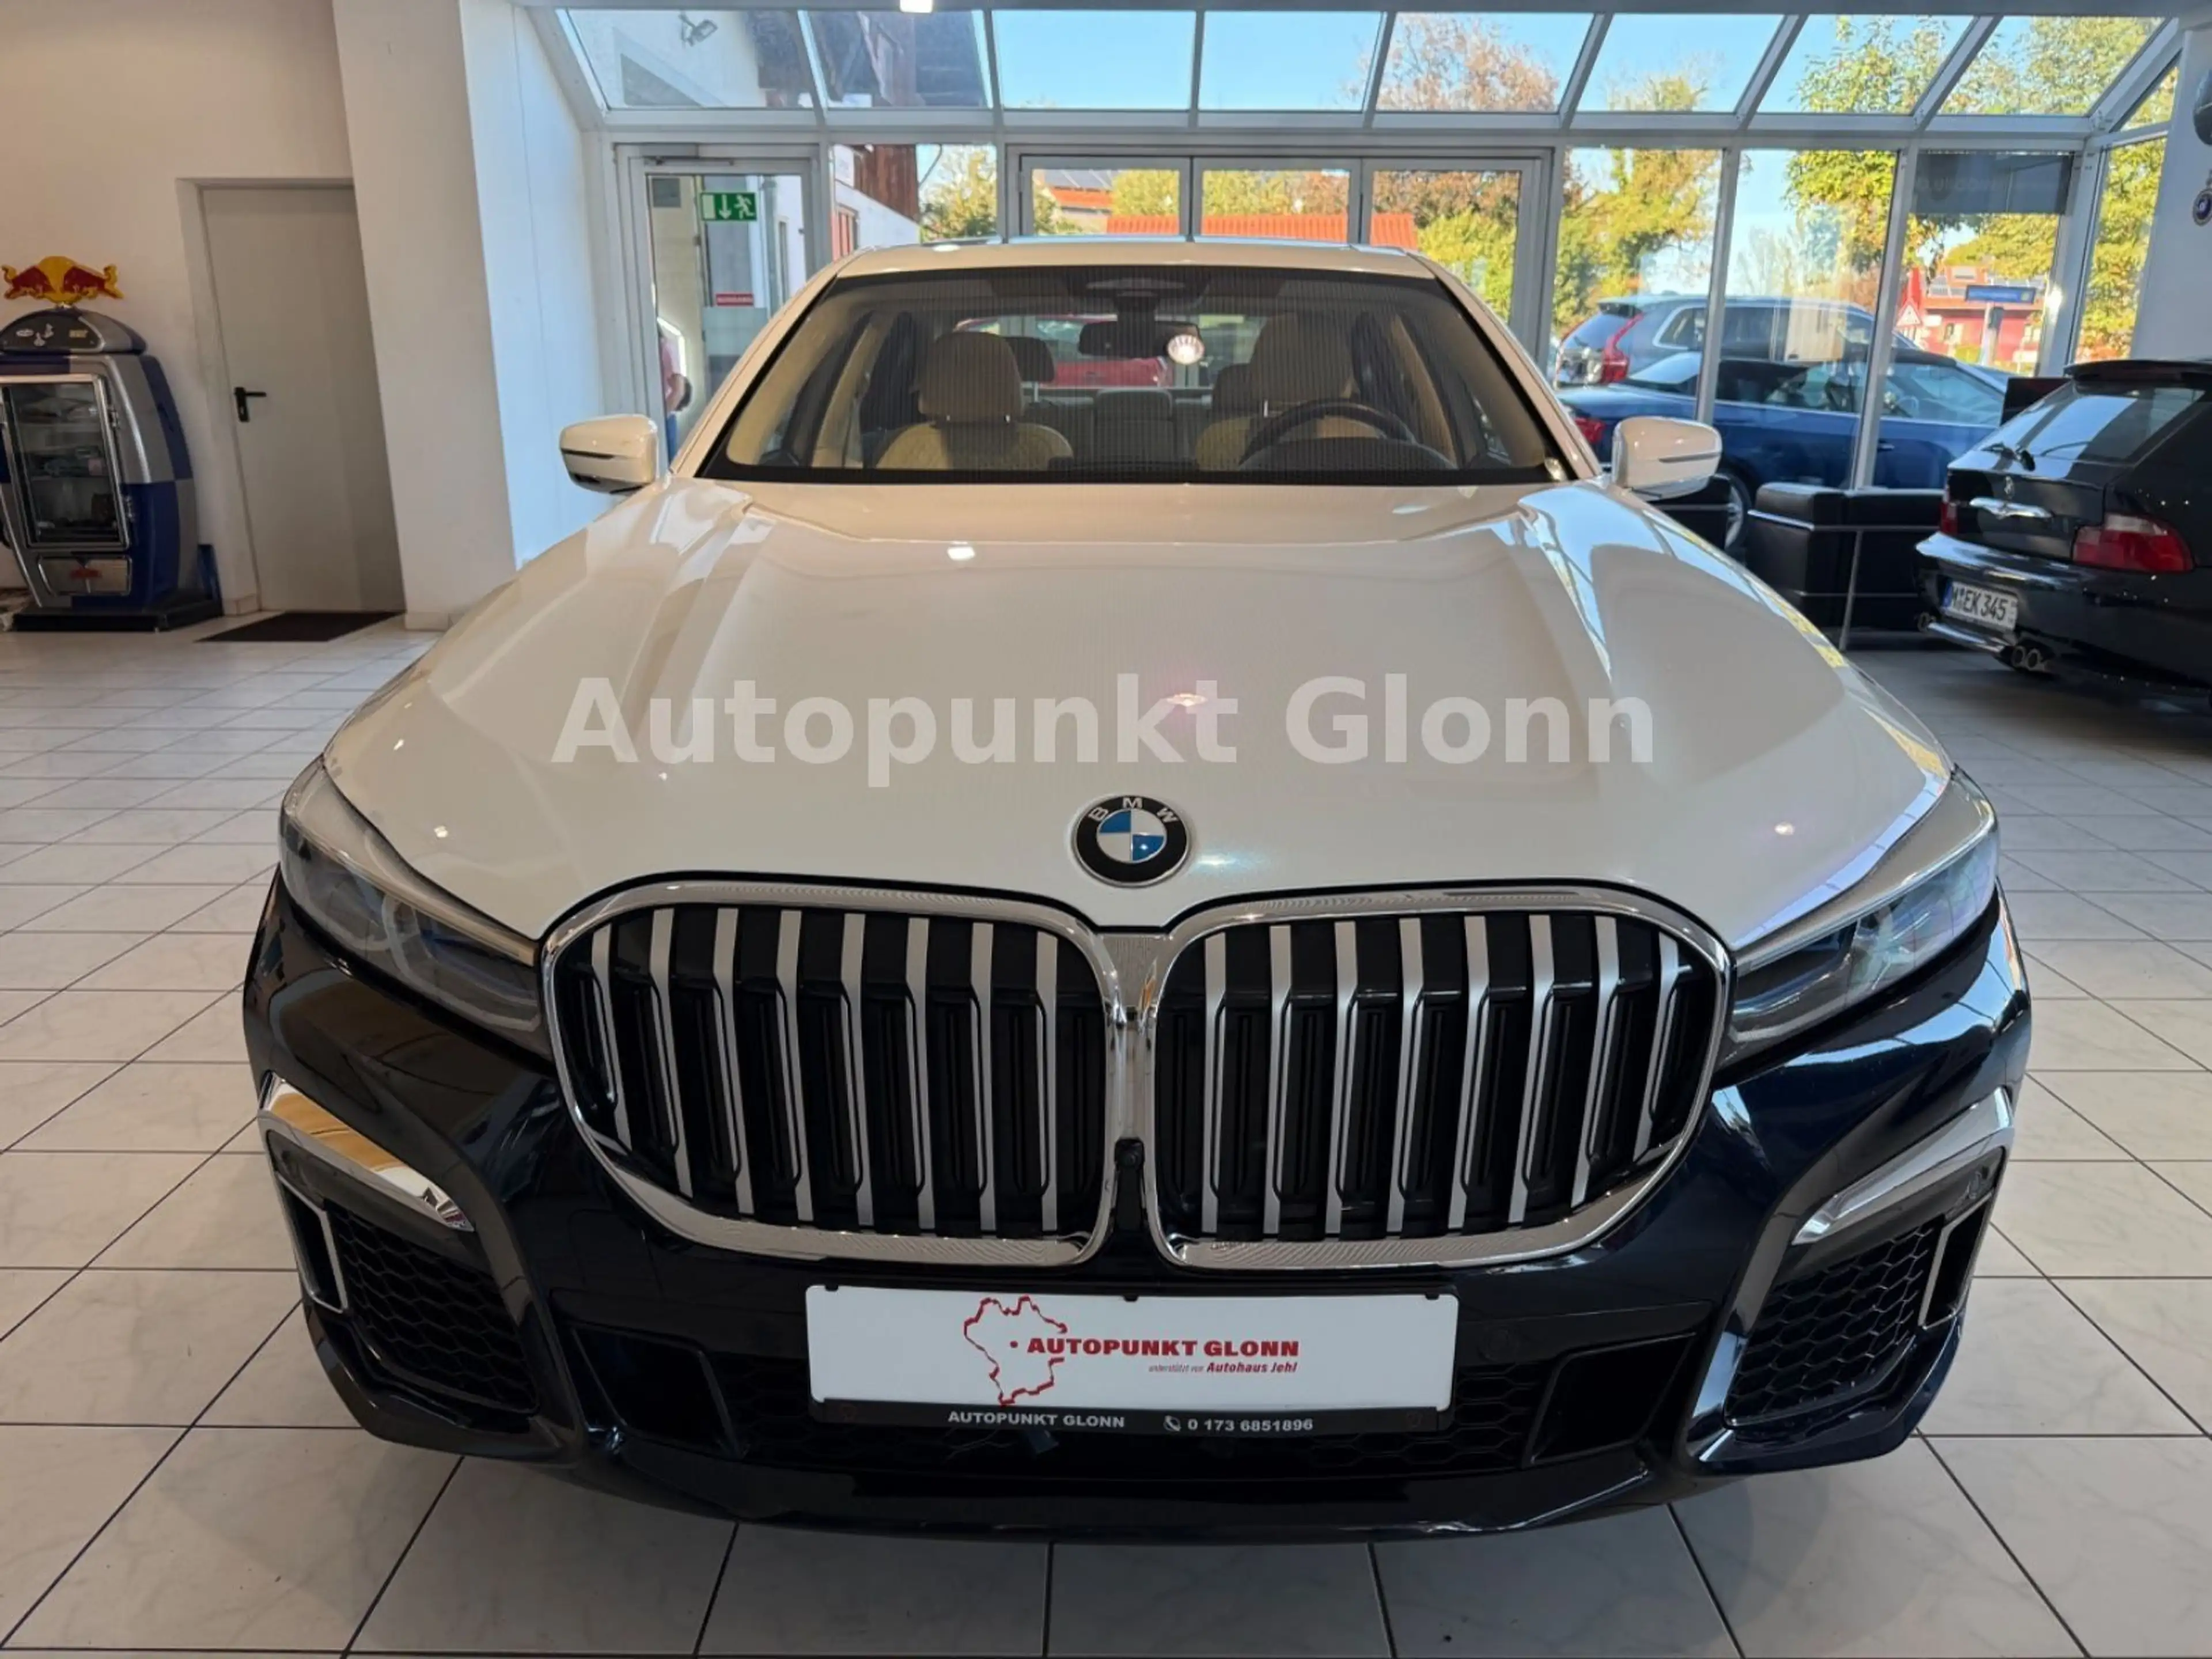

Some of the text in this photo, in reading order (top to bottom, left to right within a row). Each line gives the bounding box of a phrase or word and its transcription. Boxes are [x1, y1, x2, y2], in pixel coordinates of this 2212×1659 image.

[1963, 589, 1981, 615] EK
[1980, 594, 2009, 621] 345
[1088, 797, 1179, 823] BMW
[1027, 1338, 1300, 1357] AUTOPUNKT GLONN
[1206, 1362, 1268, 1373] Autohaus
[1270, 1362, 1298, 1373] Jehl
[948, 1411, 1314, 1432] AUTOPUNKT GLONN 0 173 6851896
